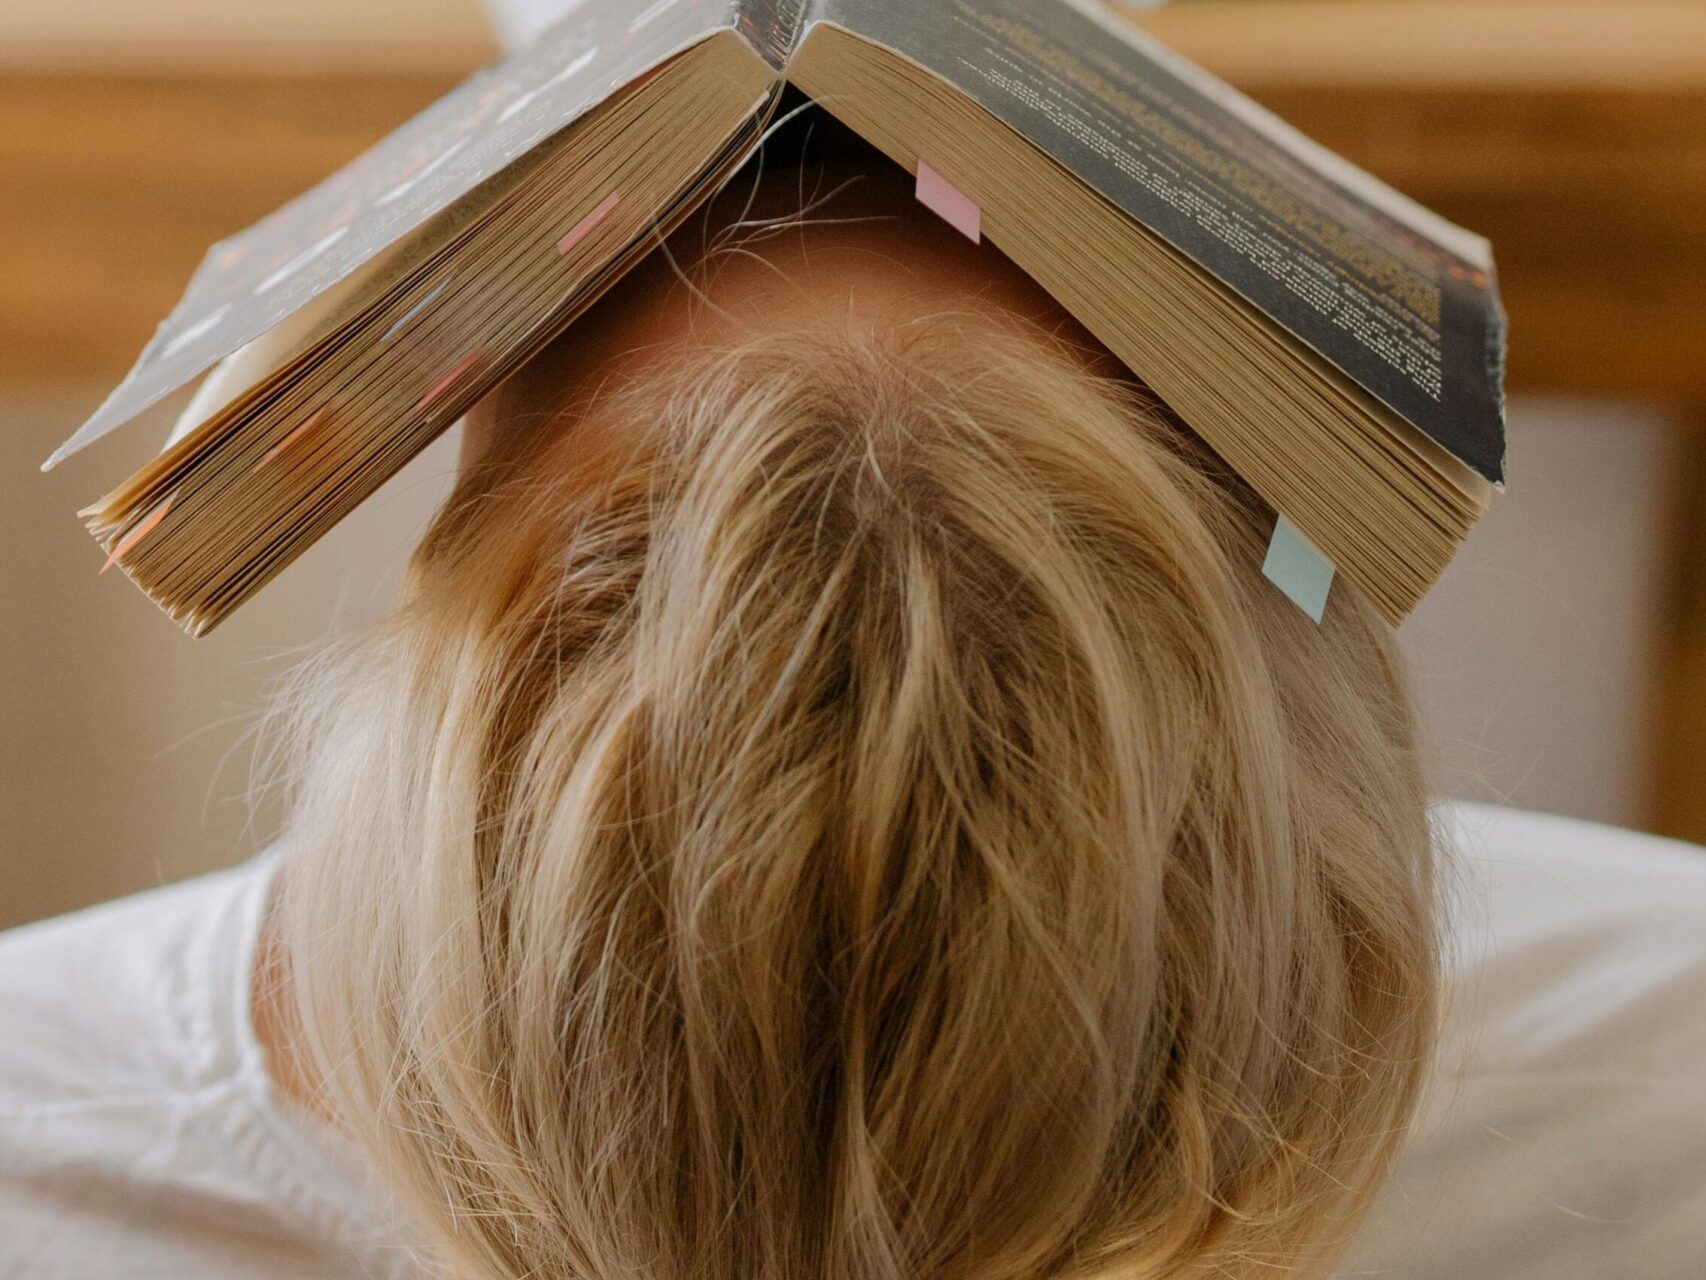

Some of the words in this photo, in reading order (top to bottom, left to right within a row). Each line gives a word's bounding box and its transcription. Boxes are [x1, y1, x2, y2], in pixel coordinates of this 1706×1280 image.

[1043, 111, 1109, 160] scientific
[1114, 160, 1190, 218] traditional
[1196, 217, 1244, 256] across
[1248, 255, 1279, 282] cuts
[1284, 281, 1327, 317] chaos
[1331, 315, 1347, 332] of
[1352, 330, 1407, 377] science
[1411, 374, 1440, 403] The
